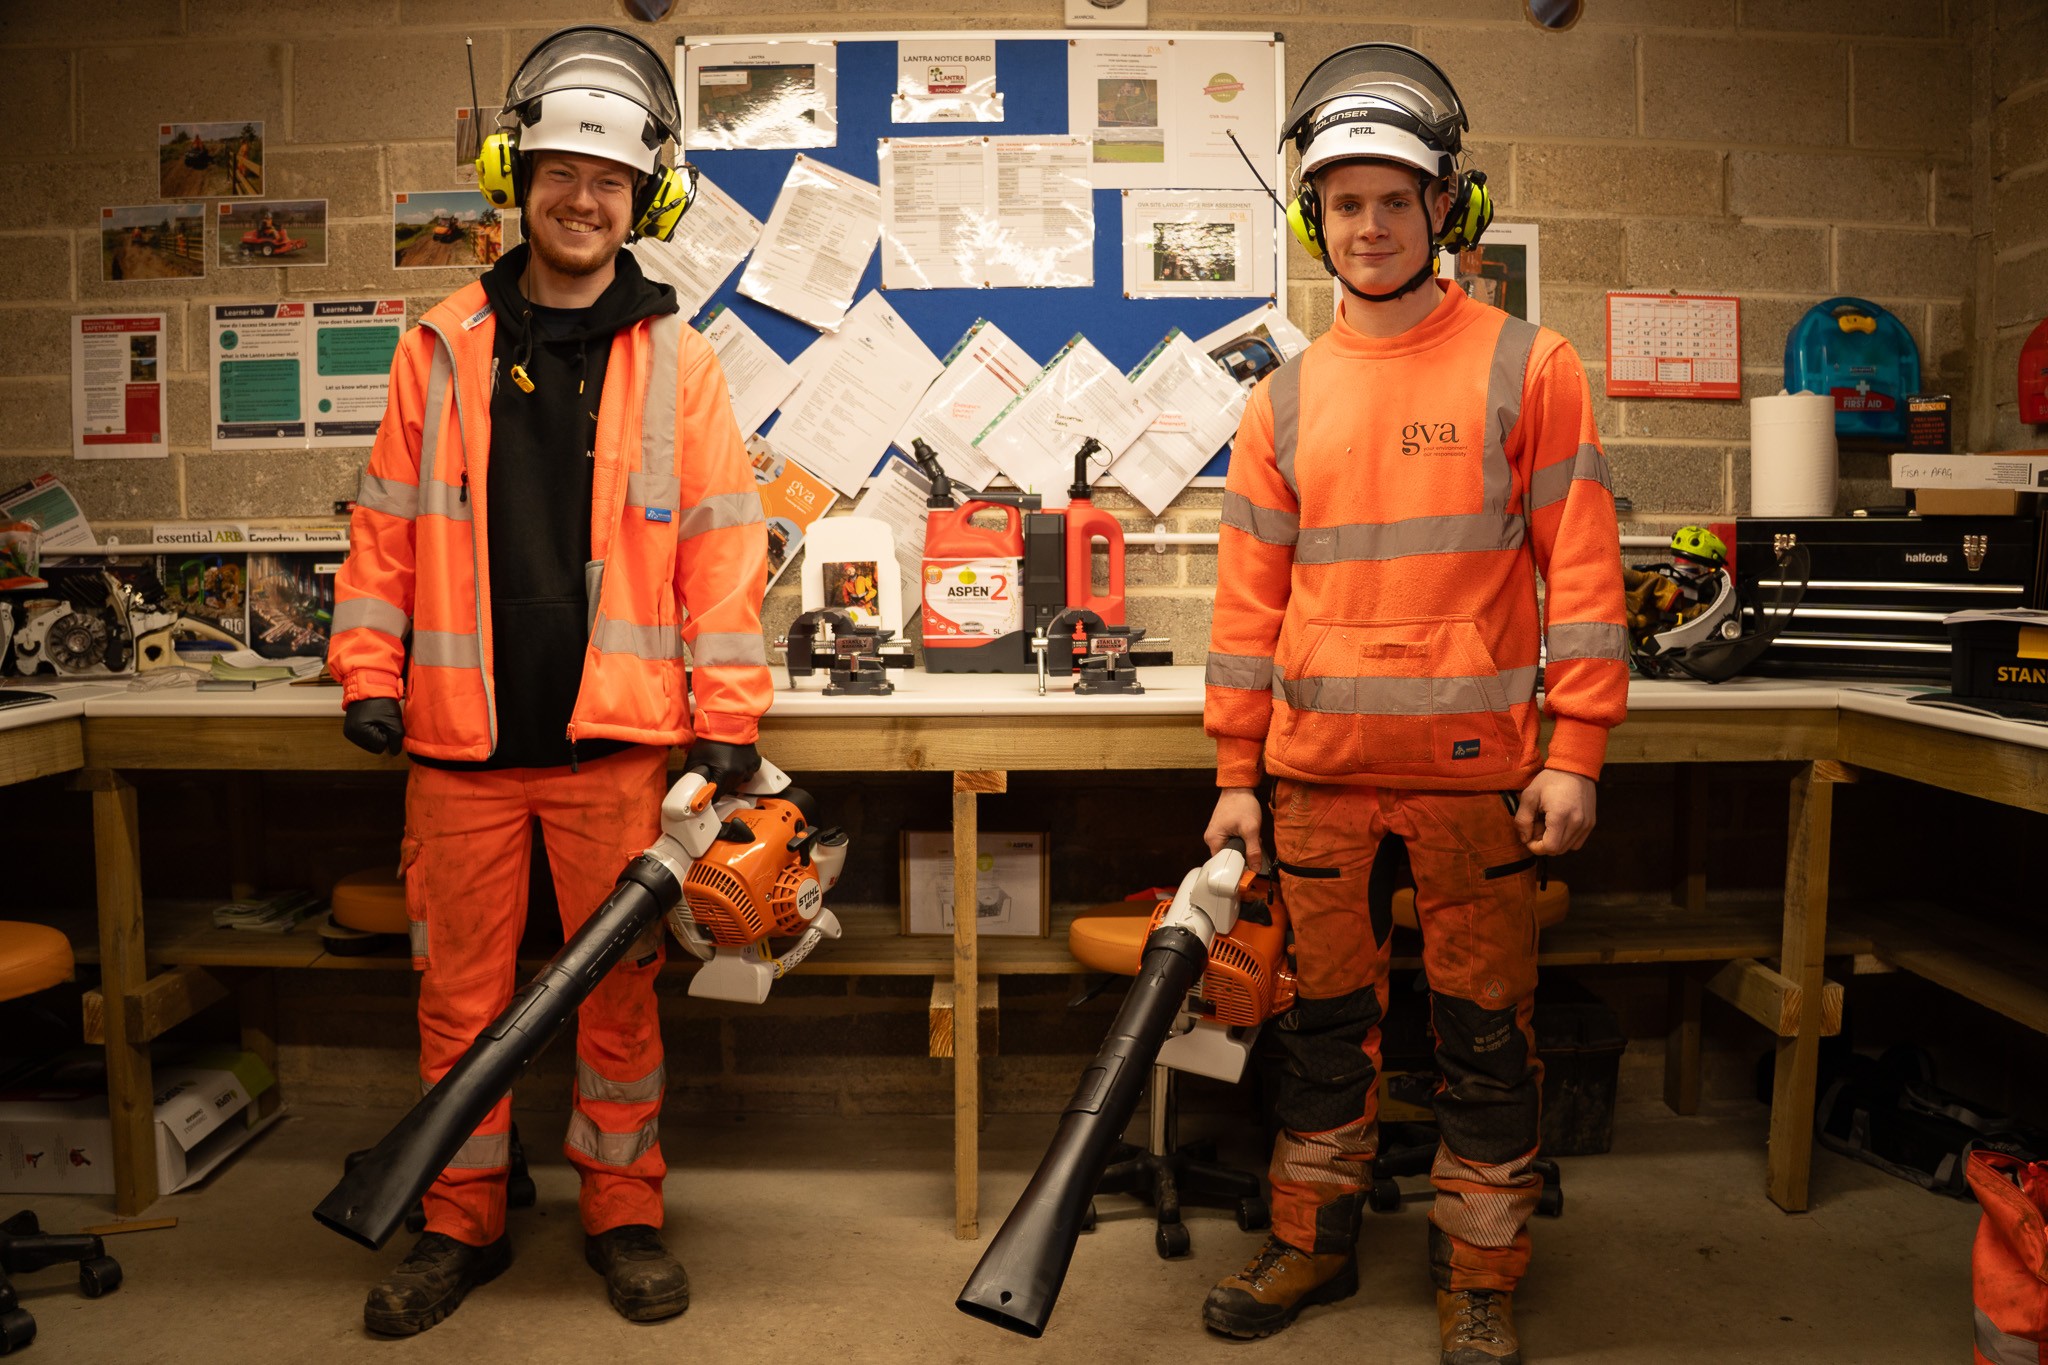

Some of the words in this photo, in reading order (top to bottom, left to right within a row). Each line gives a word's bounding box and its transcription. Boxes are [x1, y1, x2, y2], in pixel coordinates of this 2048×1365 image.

[580, 121, 606, 134] PETZL
[1349, 126, 1376, 138] PETZL
[1843, 400, 1866, 408] FIRST
[1867, 399, 1882, 408] AID
[1402, 422, 1459, 456] gva
[786, 480, 816, 505] gva
[156, 531, 213, 544] essential
[214, 531, 244, 543] ARB
[1905, 552, 1948, 563] halfords
[947, 586, 989, 597] ASPEN
[990, 575, 1008, 601] 2
[798, 885, 820, 907] STIHL
